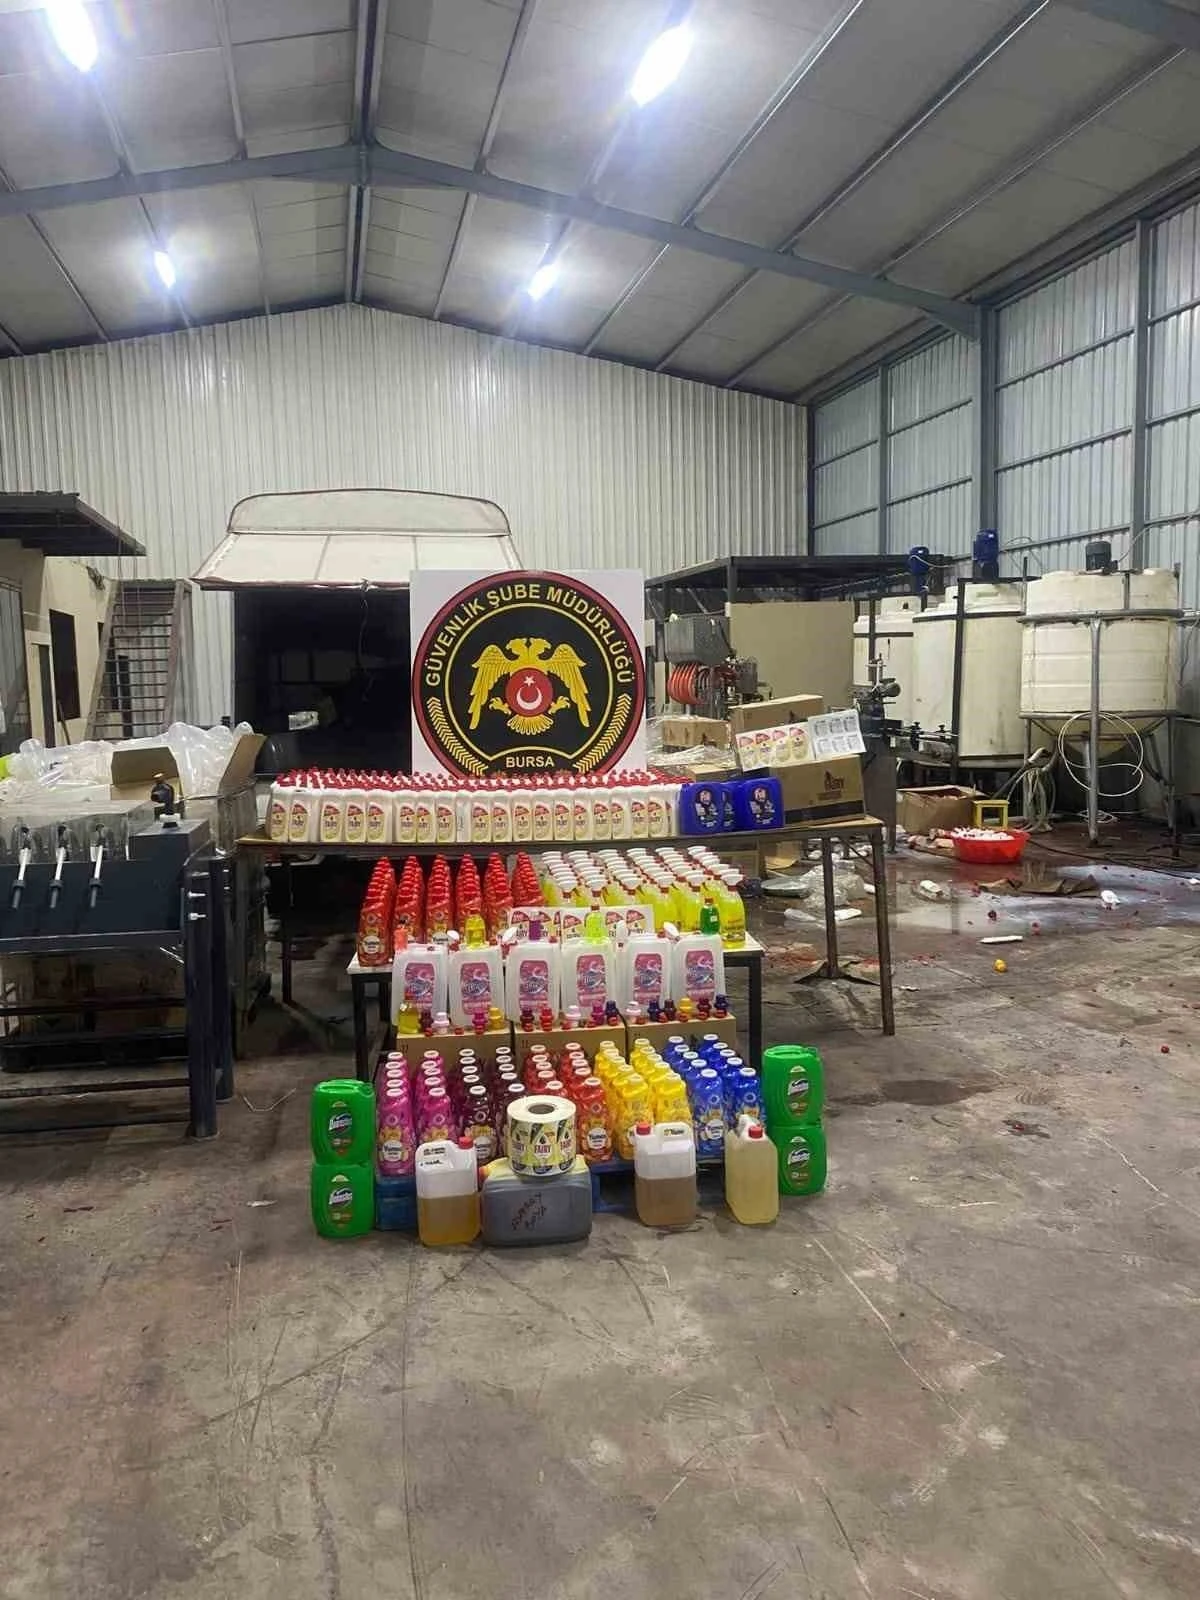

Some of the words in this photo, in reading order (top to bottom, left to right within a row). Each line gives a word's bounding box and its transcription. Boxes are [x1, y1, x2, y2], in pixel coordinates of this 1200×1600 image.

[424, 598, 486, 687] GÜVENLİK
[486, 583, 541, 606] ŞUBE
[546, 586, 635, 683] MÜDÜRLÜĞÜ
[505, 755, 555, 768] BURSA
